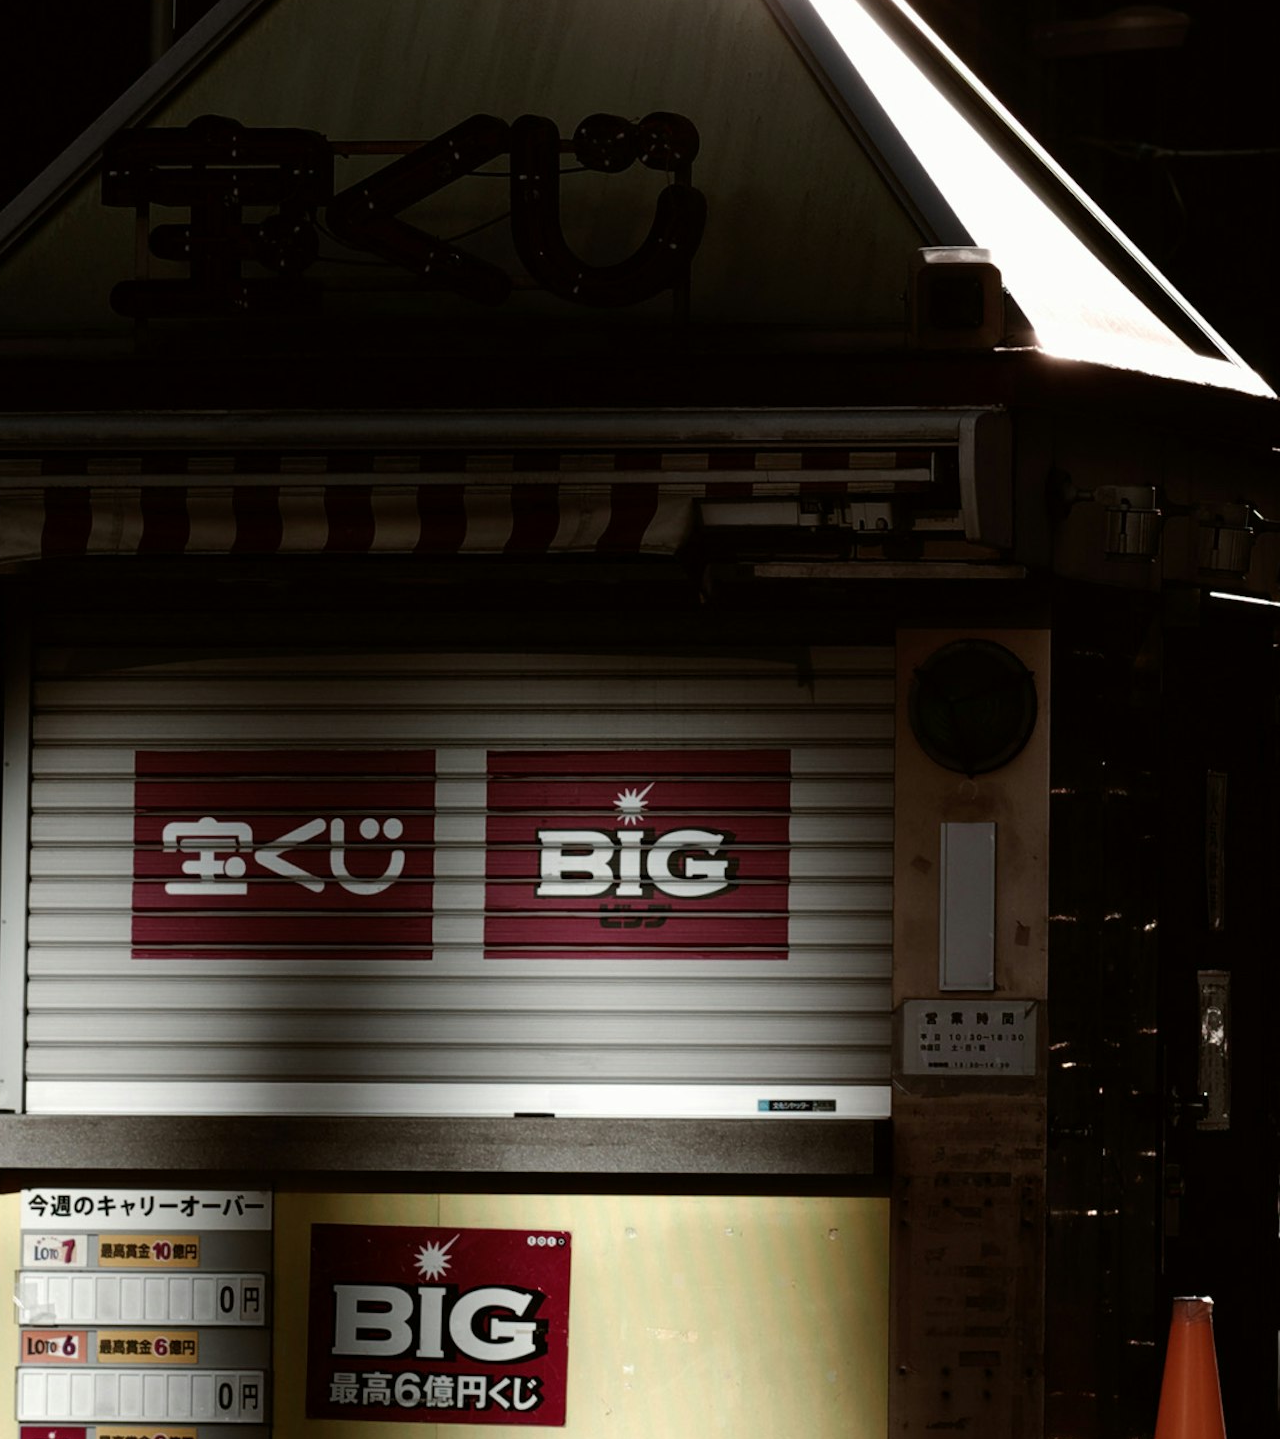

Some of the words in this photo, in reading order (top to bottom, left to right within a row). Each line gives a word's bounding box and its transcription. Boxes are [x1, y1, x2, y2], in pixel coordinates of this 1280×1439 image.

[102, 111, 708, 319] 宝くじ
[162, 816, 406, 896] 宝くじ
[536, 827, 733, 899] BIG
[925, 1012, 1014, 1025] 営業時間
[29, 1195, 264, 1217] 今週のキャリーオーバー
[34, 1245, 59, 1261] LOTO
[62, 1239, 75, 1263] 7
[101, 1242, 198, 1261] 最高賞金10億円
[331, 1283, 542, 1363] BIG
[27, 1338, 57, 1355] LOTO
[62, 1335, 76, 1356] 6
[99, 1338, 196, 1356] 最高賞金6億円
[328, 1370, 544, 1412] 最高6億円くじ
